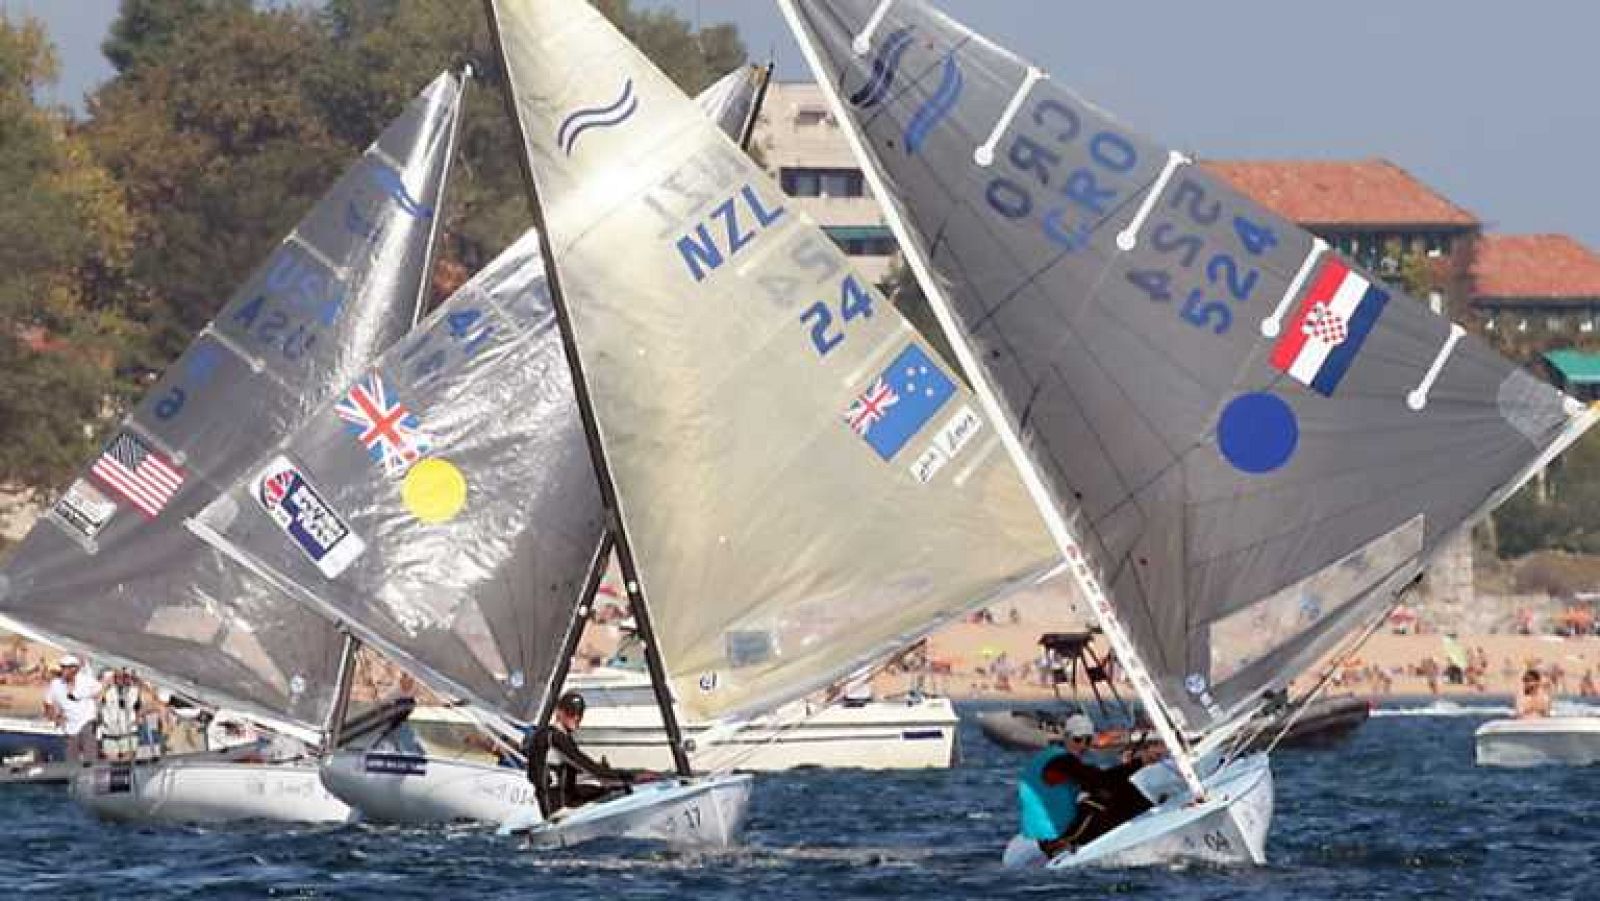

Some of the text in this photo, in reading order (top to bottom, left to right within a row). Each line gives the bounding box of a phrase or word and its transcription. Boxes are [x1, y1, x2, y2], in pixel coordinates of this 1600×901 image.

[676, 183, 784, 281] NZL
[1041, 130, 1137, 250] CRO
[799, 273, 873, 356] 24
[1178, 216, 1279, 334] 524
[683, 806, 701, 829] 17
